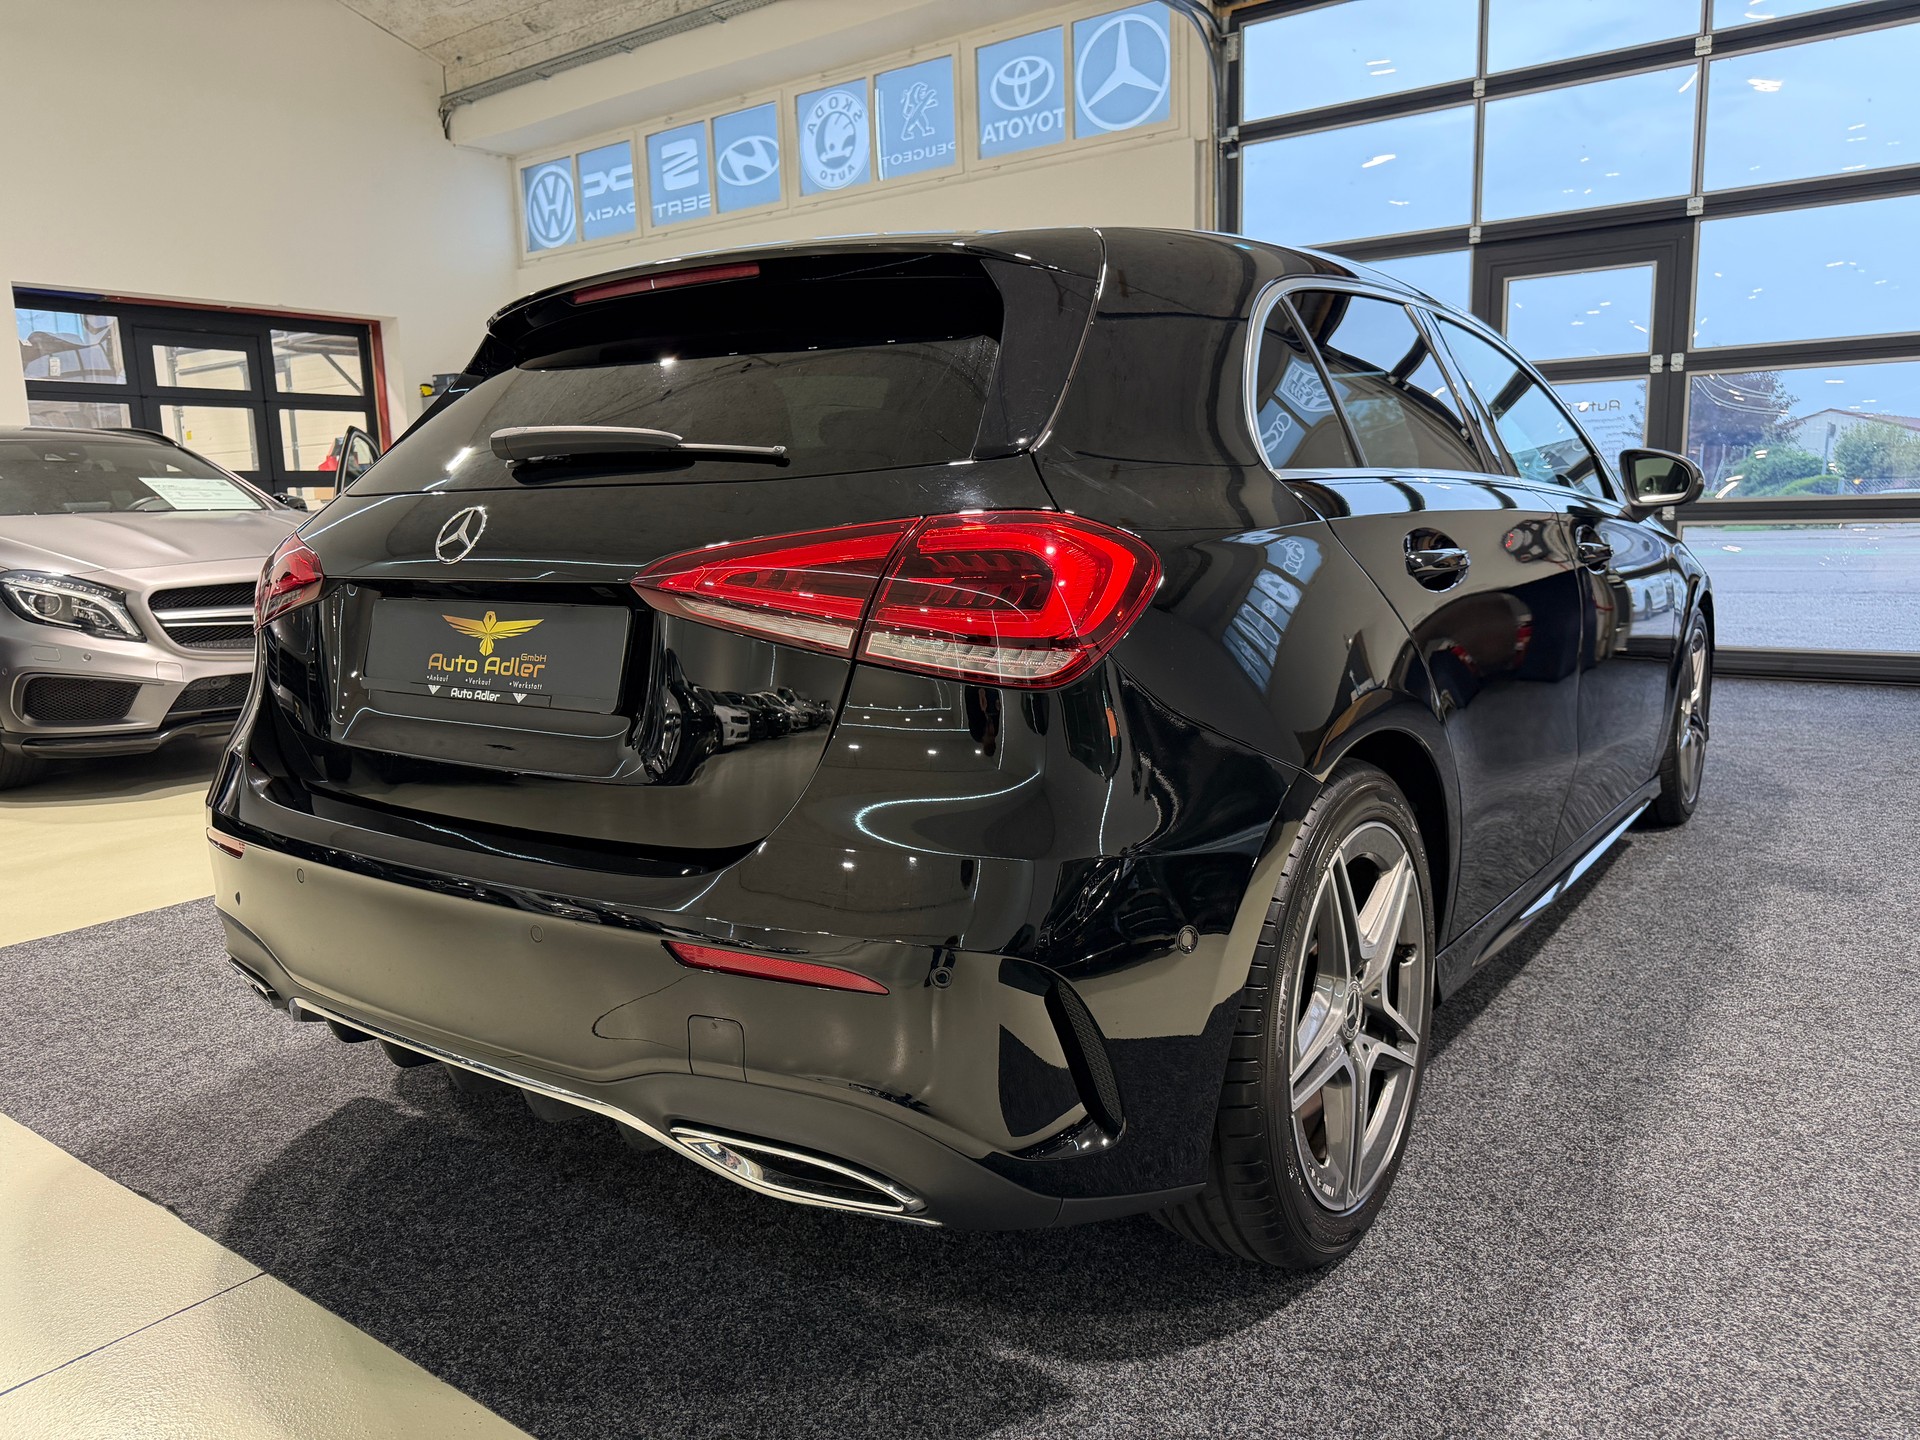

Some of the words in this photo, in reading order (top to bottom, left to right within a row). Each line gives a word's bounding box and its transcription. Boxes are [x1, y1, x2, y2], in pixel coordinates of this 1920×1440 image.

[428, 652, 478, 673] Auto
[484, 656, 546, 678] Adler
[520, 653, 547, 663] GmbH
[450, 687, 473, 699] Auto
[474, 689, 501, 702] Adler
